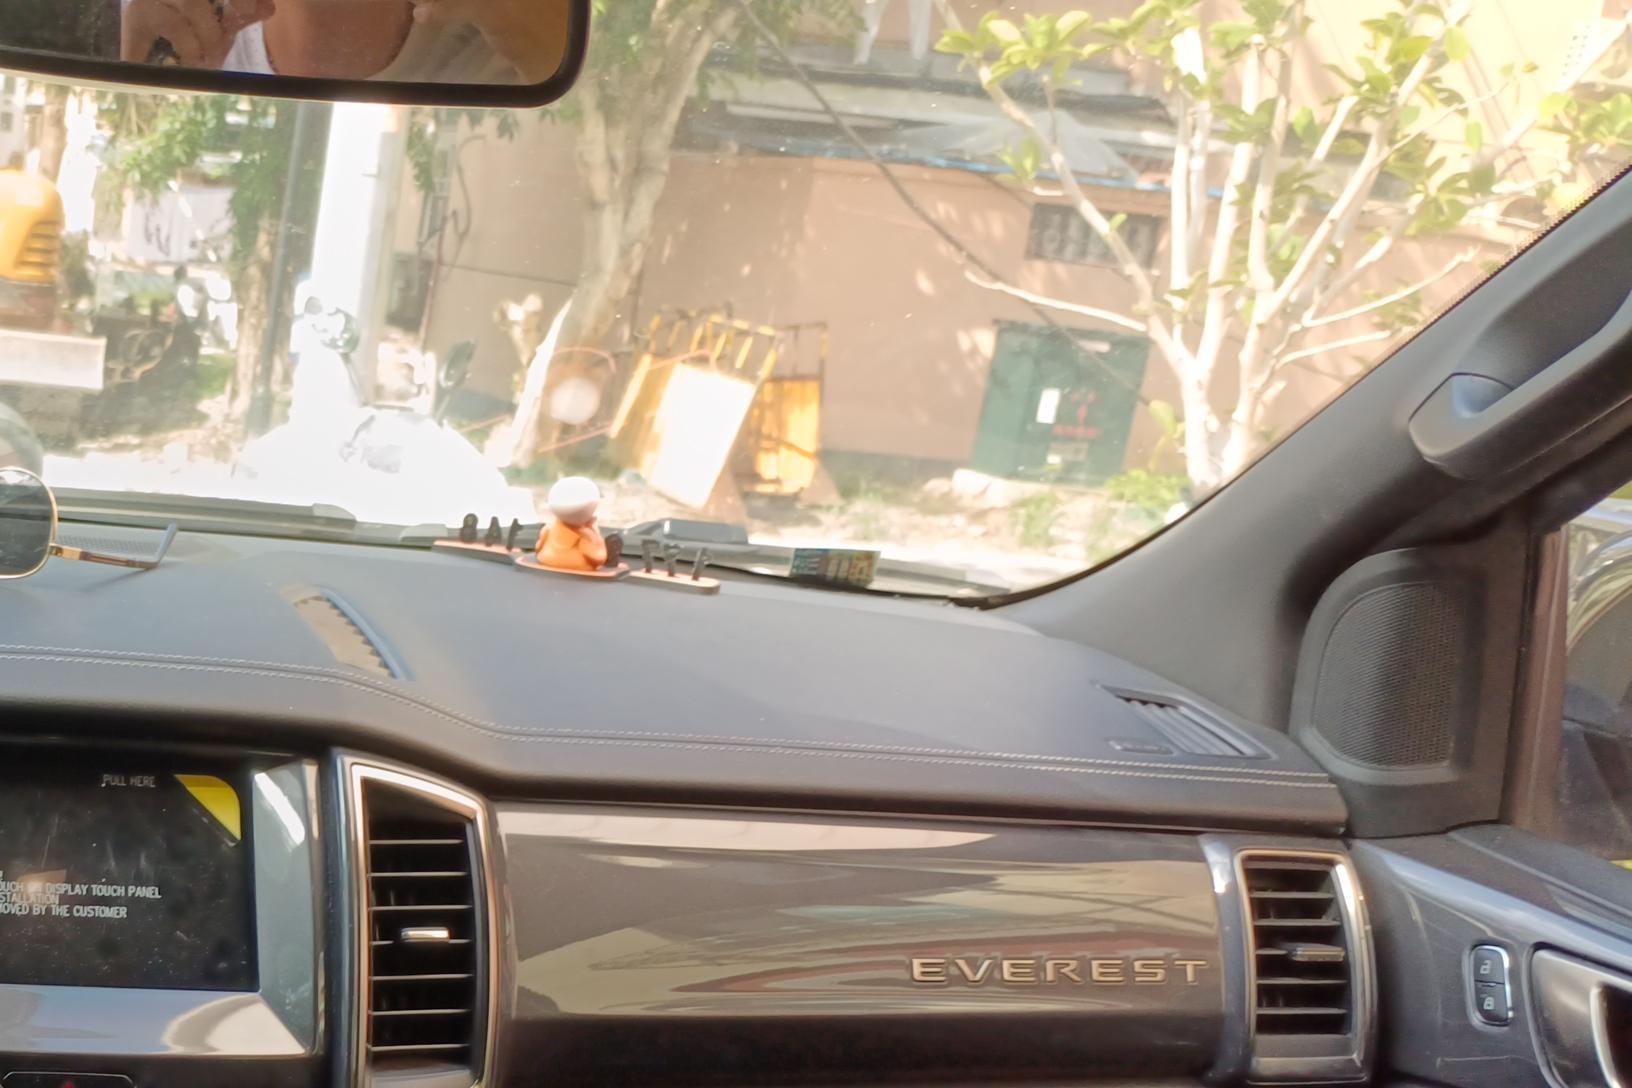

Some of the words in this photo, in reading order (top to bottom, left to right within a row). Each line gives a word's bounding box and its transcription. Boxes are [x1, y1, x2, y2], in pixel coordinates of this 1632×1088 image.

[101, 774, 127, 787] PULL
[129, 775, 156, 788] HERE
[46, 883, 89, 896] DISPLAY
[91, 884, 126, 897] TOUCH
[128, 885, 162, 899] PANEL
[32, 904, 48, 915] BY
[51, 904, 70, 917] THE
[73, 905, 128, 918] CUSTOMER
[911, 957, 1210, 984] EVEREST
